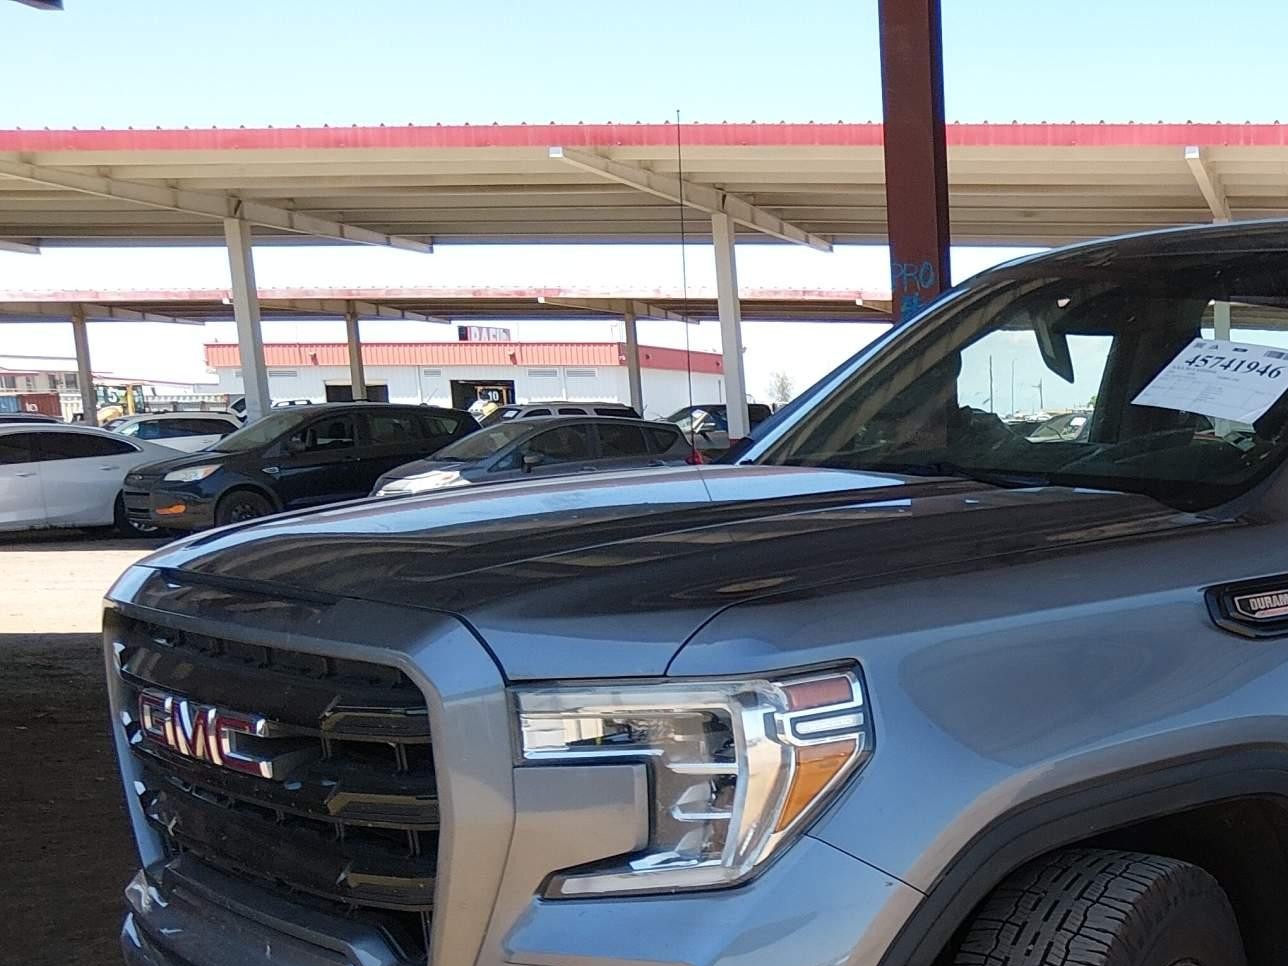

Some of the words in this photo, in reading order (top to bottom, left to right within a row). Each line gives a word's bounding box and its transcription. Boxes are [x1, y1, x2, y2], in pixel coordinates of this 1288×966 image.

[1185, 353, 1287, 379] 45741946
[487, 390, 500, 401] 10
[138, 690, 273, 779] GMC
